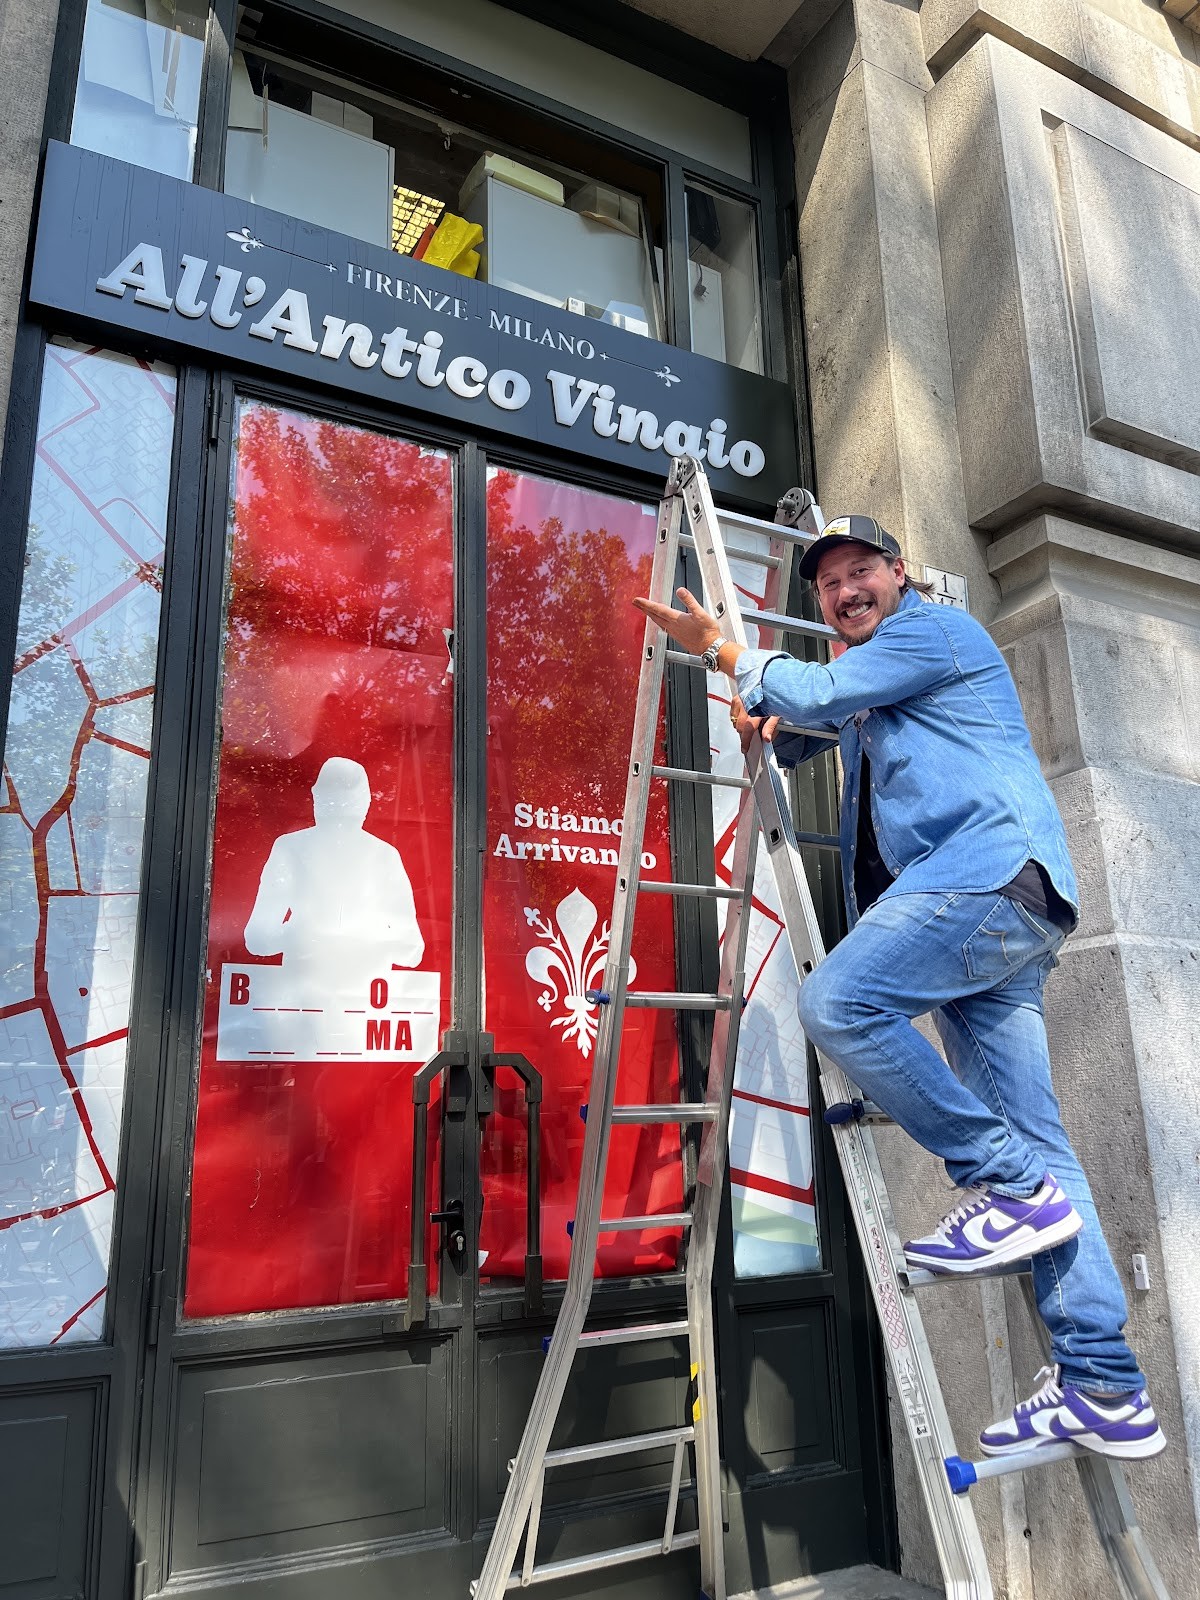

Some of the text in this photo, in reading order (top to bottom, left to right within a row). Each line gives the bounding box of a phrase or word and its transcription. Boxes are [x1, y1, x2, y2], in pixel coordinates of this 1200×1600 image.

[346, 261, 469, 321] FIRENZE
[489, 309, 596, 361] MILANO
[95, 242, 766, 477] All'Antico Vinaio
[514, 803, 625, 837] Stiamo
[493, 833, 657, 869] Arrivano
[229, 972, 389, 1009] B O
[366, 1019, 413, 1051] MA
